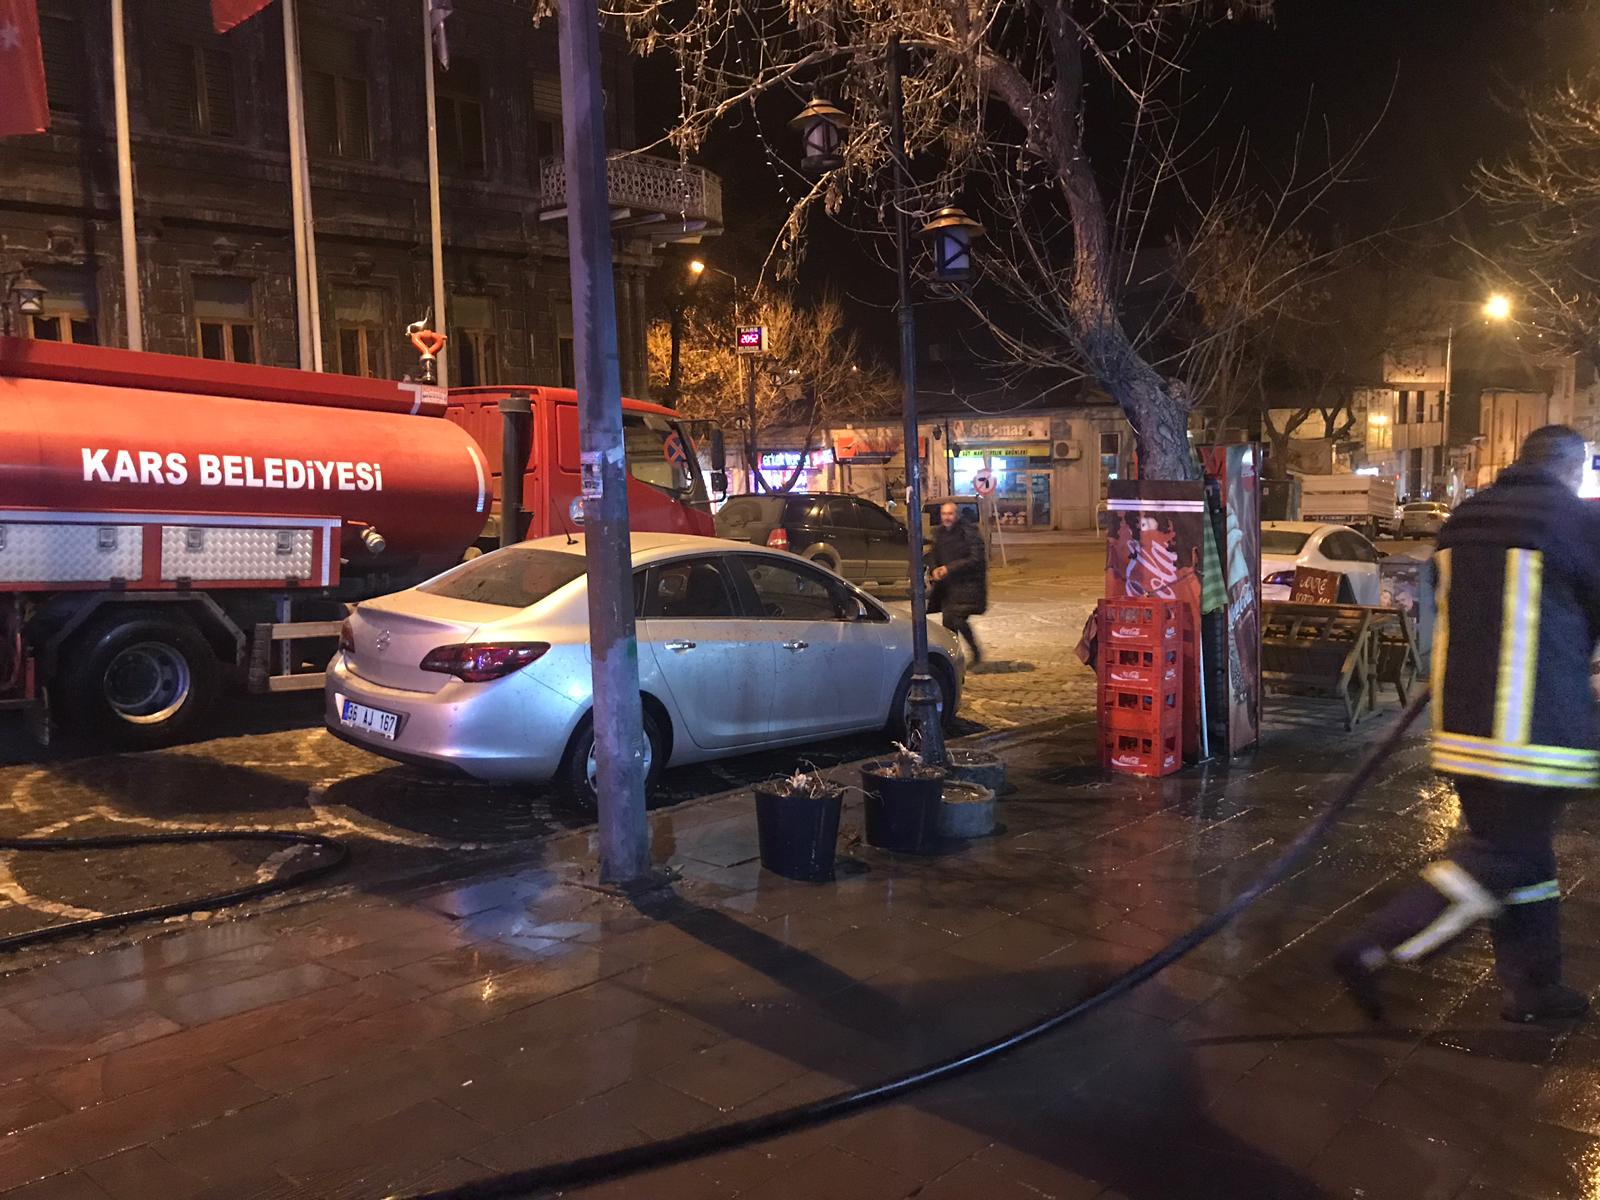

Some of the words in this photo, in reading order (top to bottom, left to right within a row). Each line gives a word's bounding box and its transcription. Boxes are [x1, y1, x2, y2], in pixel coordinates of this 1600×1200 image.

[81, 447, 188, 486] KARS
[347, 705, 358, 721] 36
[362, 709, 375, 727] AJ
[380, 713, 396, 732] 167
